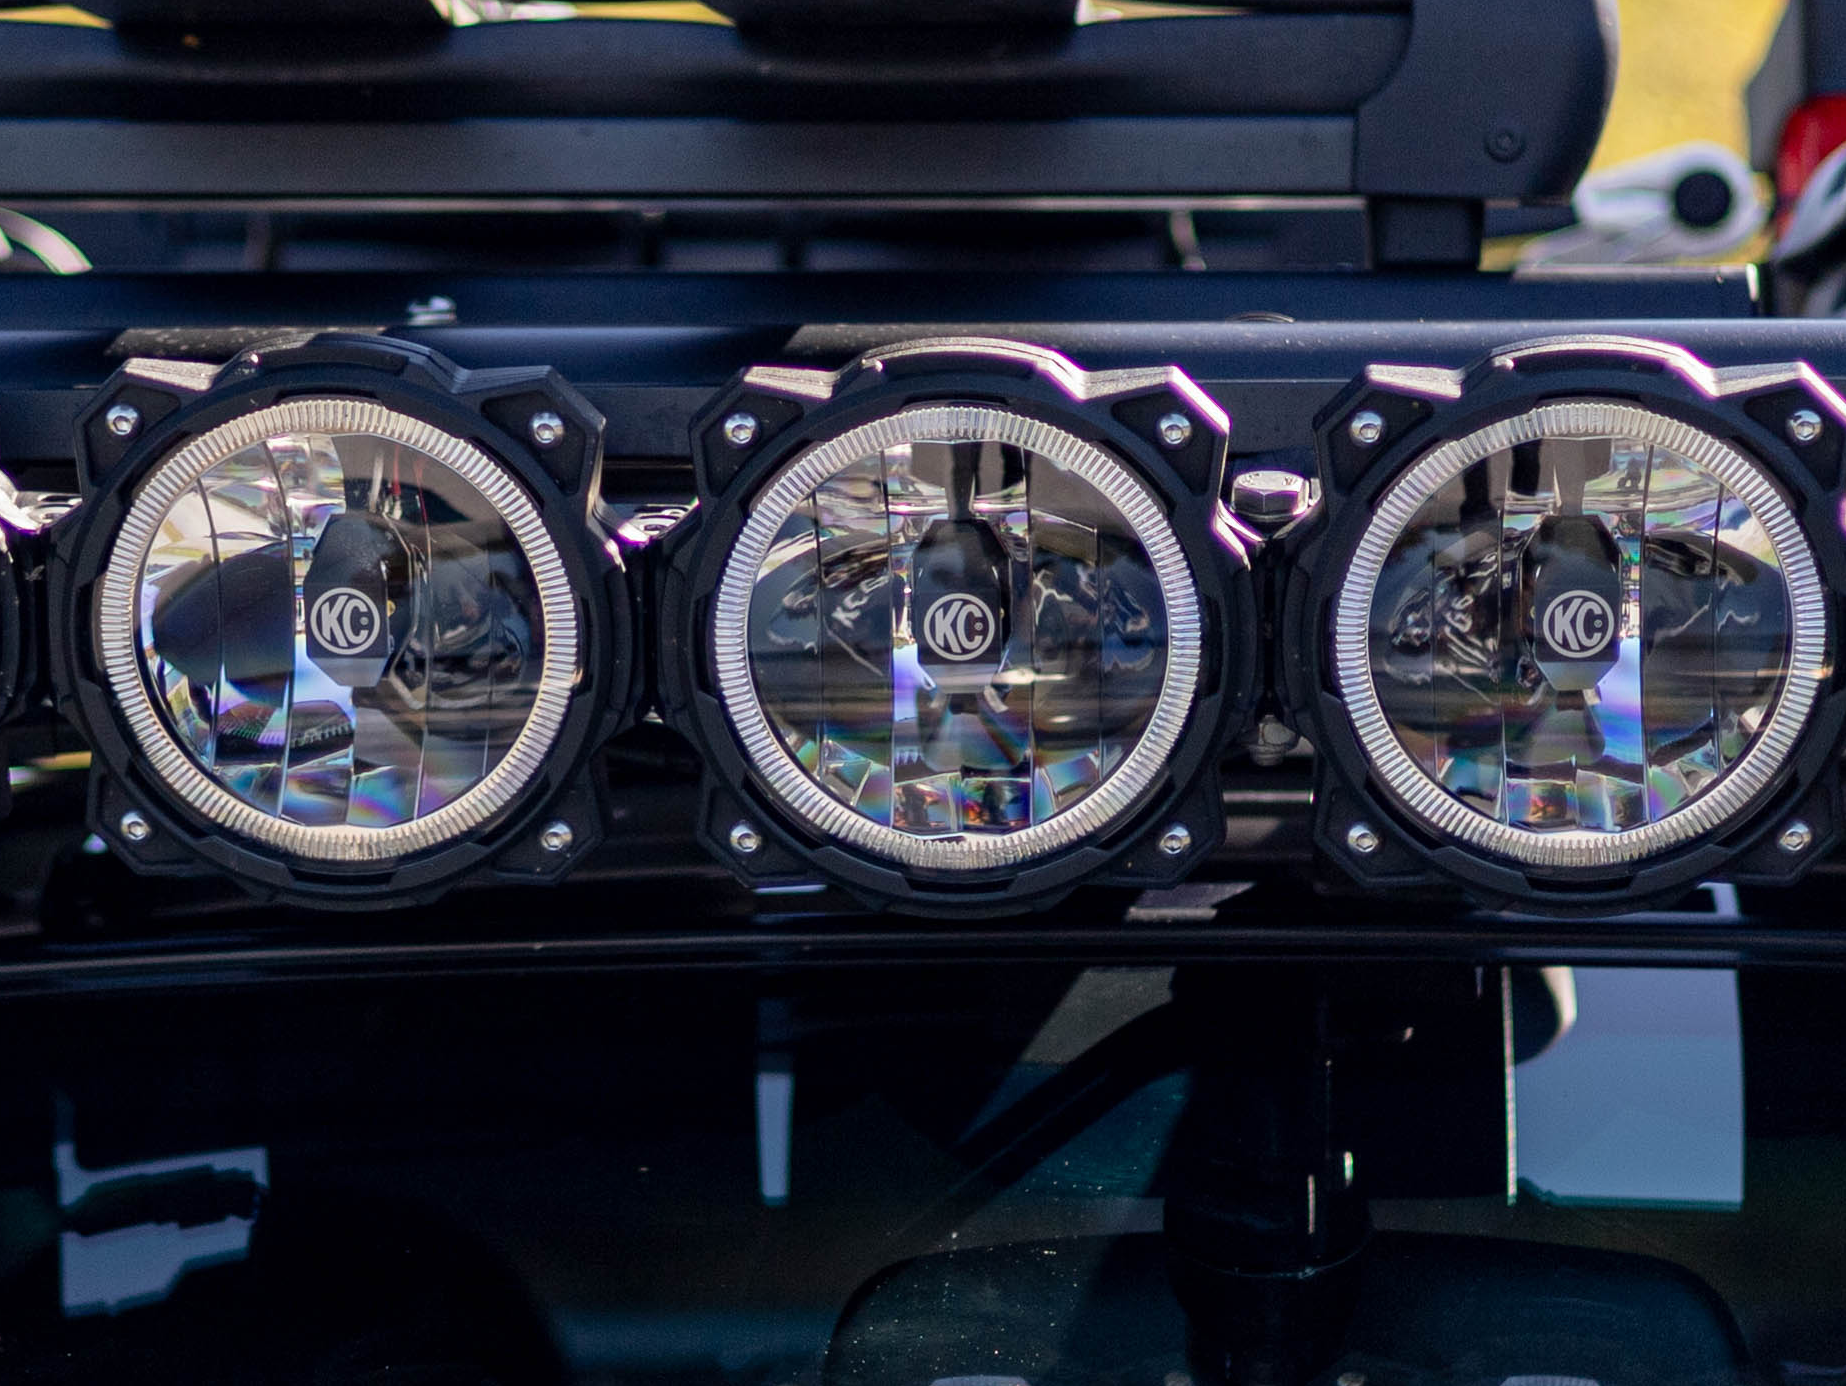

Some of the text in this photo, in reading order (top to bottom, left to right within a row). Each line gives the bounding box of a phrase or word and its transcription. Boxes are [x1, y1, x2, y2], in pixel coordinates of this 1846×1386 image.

[321, 595, 370, 647] KC
[935, 601, 984, 653] KC
[1554, 598, 1602, 650] KC
